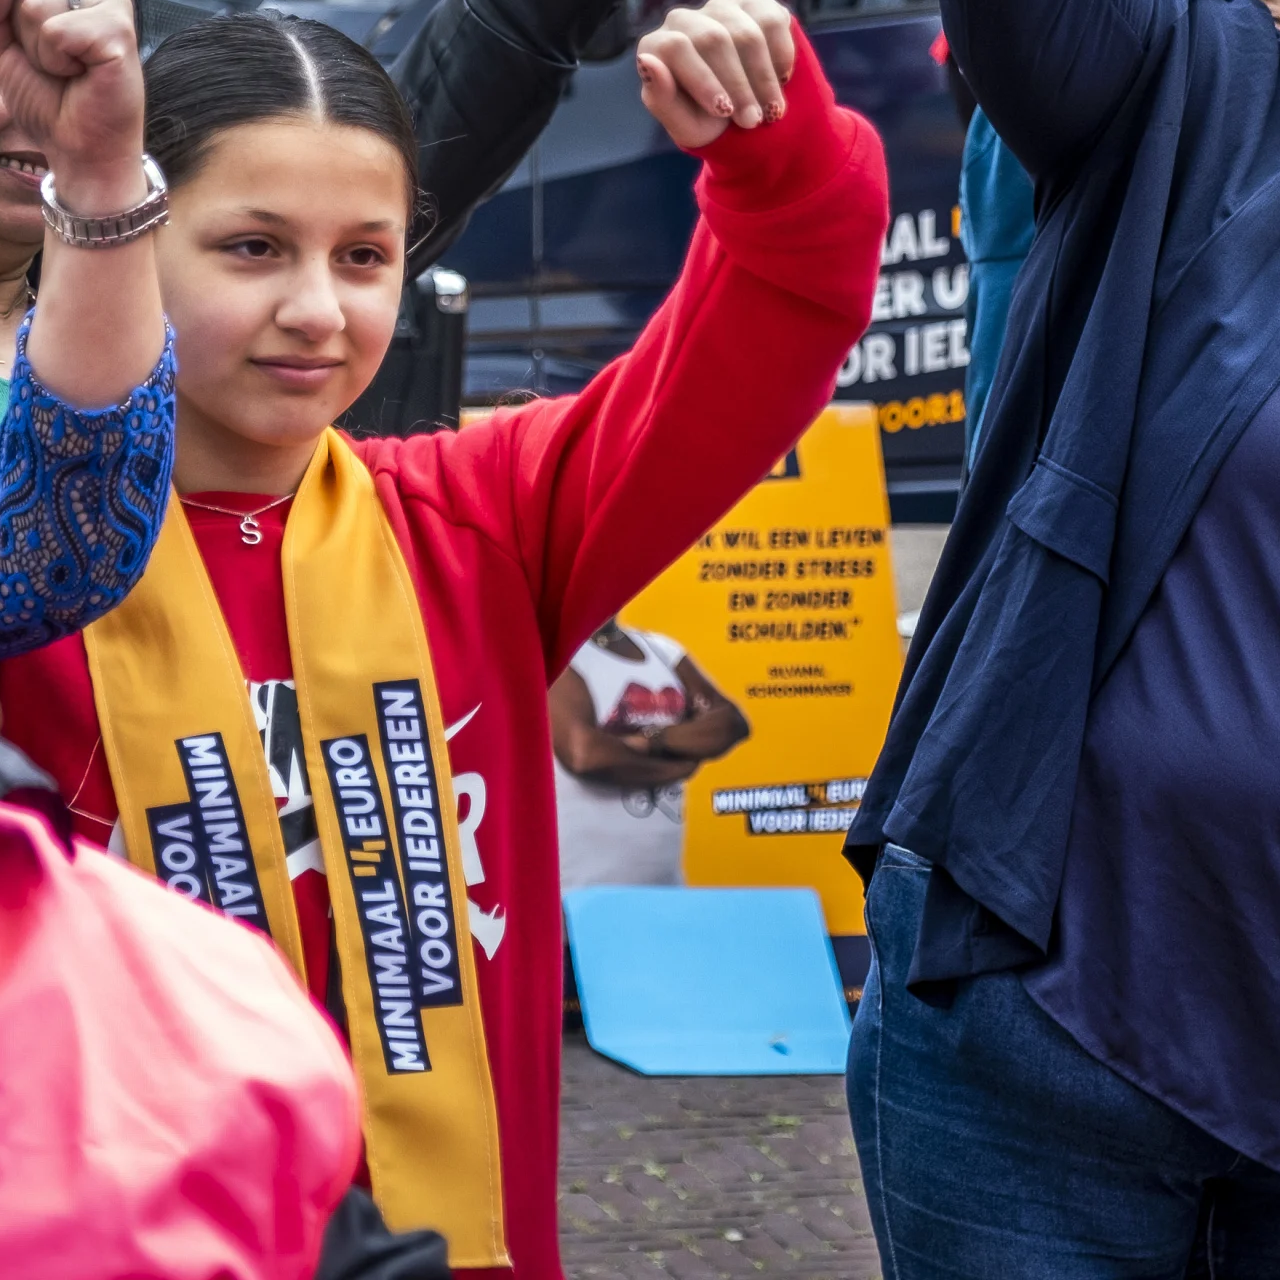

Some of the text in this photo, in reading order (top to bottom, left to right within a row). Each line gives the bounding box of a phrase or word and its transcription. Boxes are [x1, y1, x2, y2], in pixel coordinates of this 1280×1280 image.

[770, 529, 809, 549] EEN
[700, 559, 874, 581] ZONDER STRESS
[729, 590, 851, 611] EN ZONDER
[329, 739, 381, 836] EURO
[750, 808, 808, 833] VOOR
[381, 690, 454, 996] VOOR IEDEREEN
[361, 882, 424, 1072] MINIMAAL
